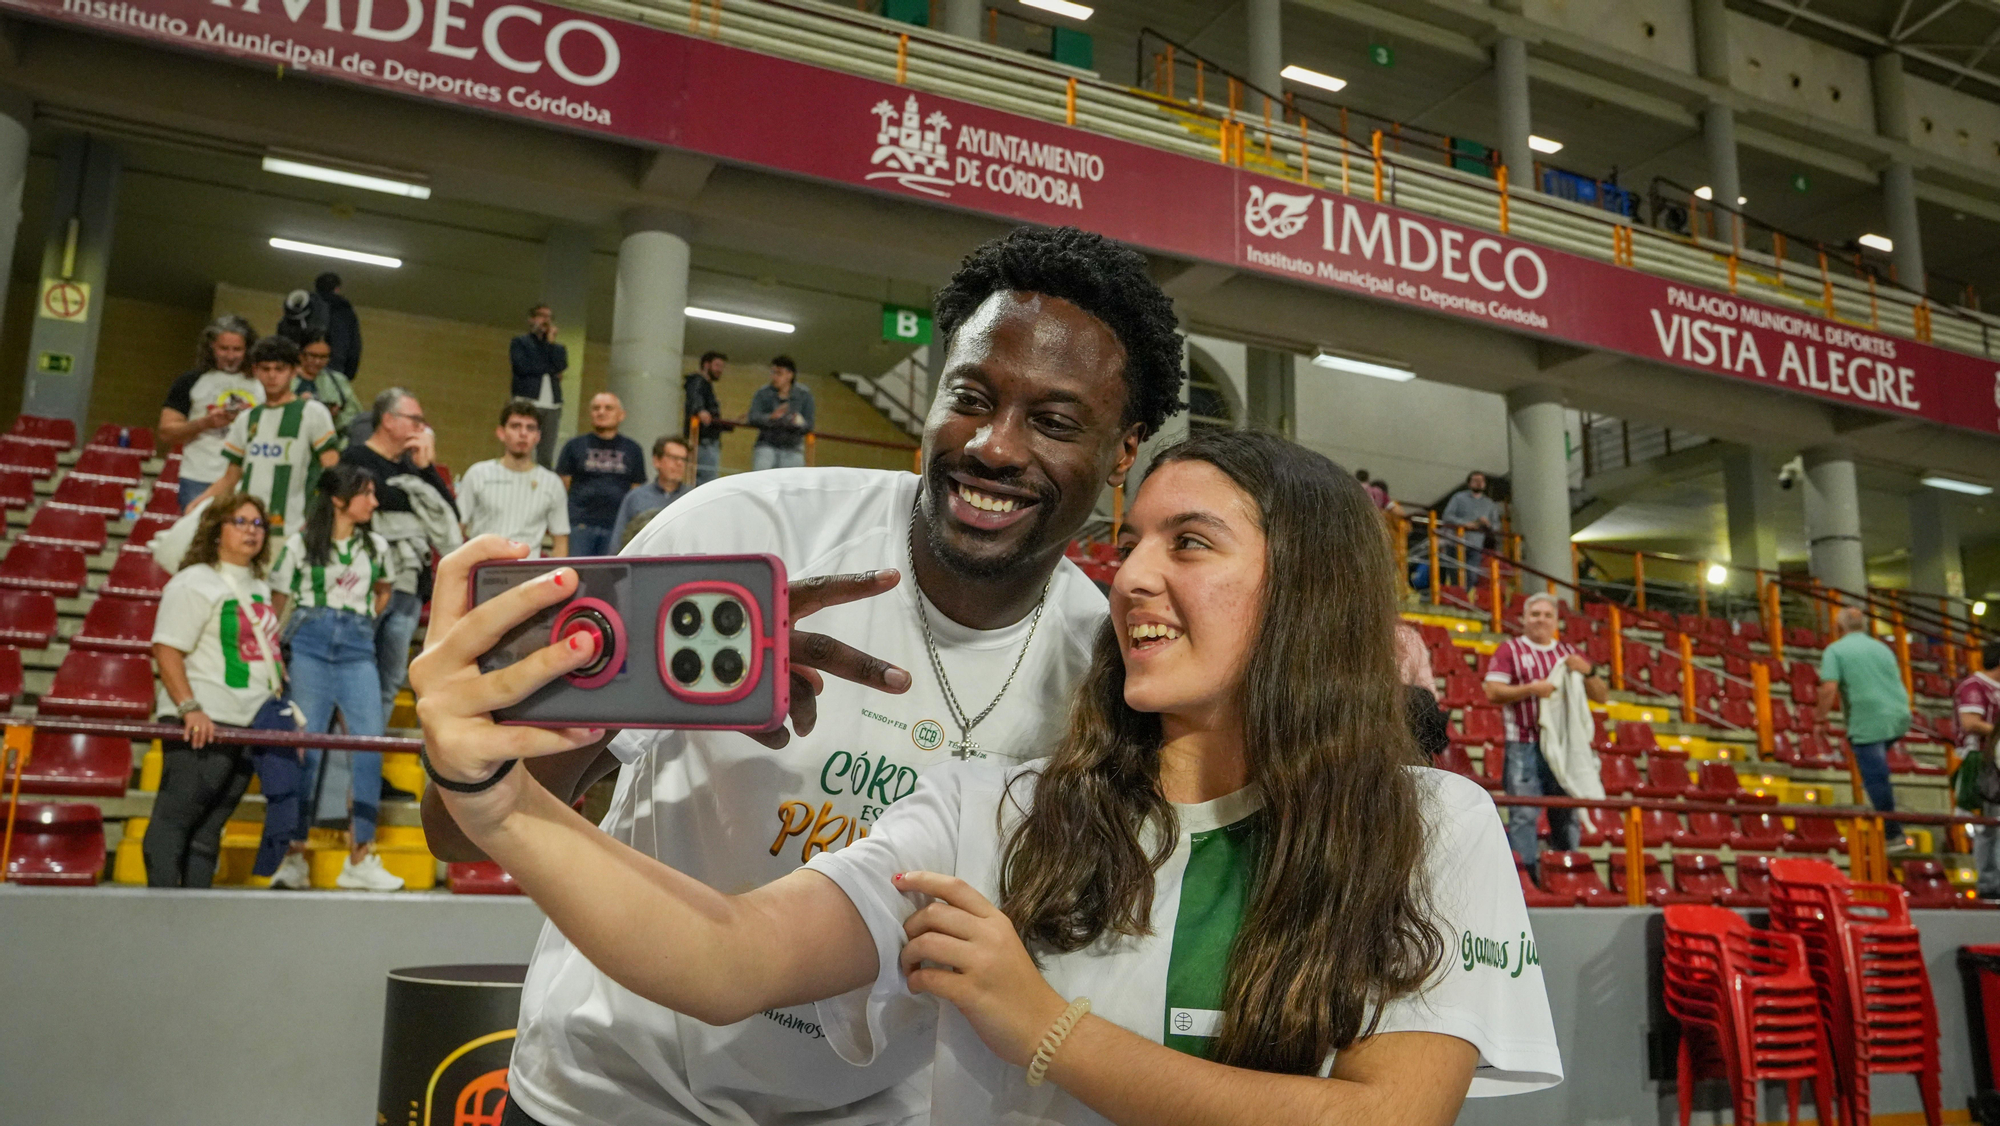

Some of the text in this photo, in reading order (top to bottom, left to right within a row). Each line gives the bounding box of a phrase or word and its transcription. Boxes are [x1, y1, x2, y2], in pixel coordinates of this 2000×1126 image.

[63, 0, 612, 126] Instituto Municipal de Deportes Córdoba
[209, 0, 621, 87] DECO
[1376, 47, 1389, 65] 3
[955, 125, 1104, 182] AYUNTAMIENTO
[955, 156, 1084, 210] DE CÓRDOBA
[1321, 198, 1548, 299] IMDECO
[1246, 245, 1549, 329] Instituto Municipal de Deportes Córdoba
[897, 310, 919, 338] B
[1666, 286, 1897, 359] PALACIO MUNICIPAL DEPORTES
[1650, 308, 1921, 410] VISTA ALEGRE
[893, 720, 908, 731] FEB
[919, 727, 938, 743] CCB
